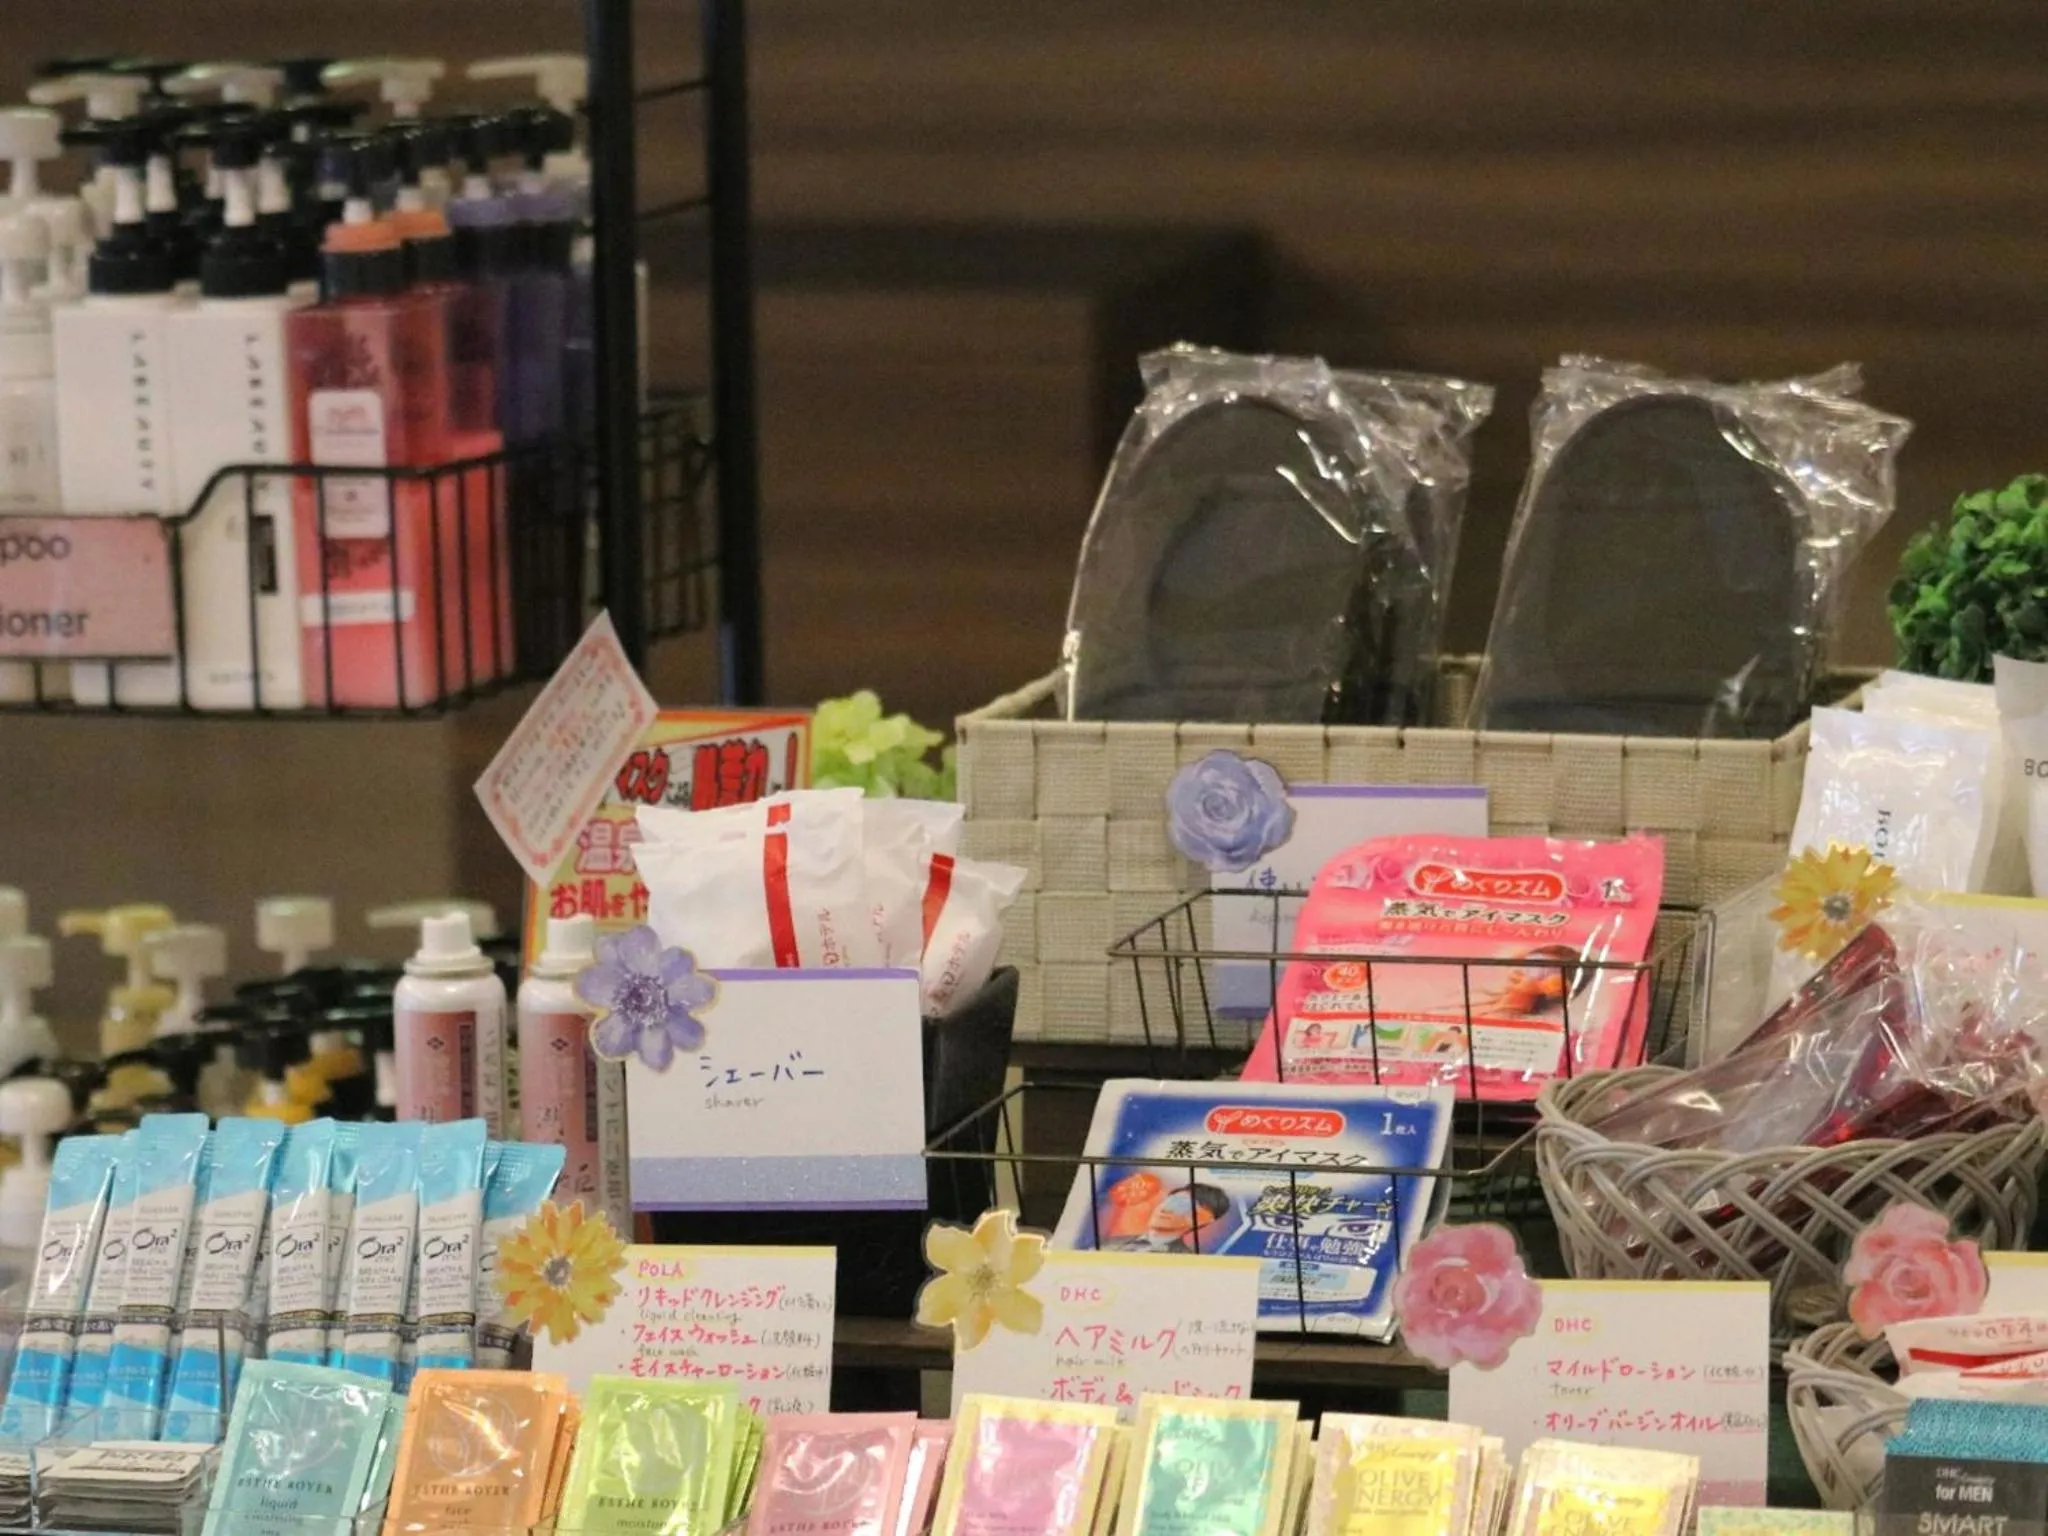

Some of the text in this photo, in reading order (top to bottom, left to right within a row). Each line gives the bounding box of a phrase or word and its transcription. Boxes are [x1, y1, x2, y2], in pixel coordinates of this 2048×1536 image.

[699, 1051, 826, 1088] シェーバー
[704, 1095, 763, 1110] shaver
[1165, 1139, 1370, 1167] 蒸気でアイマスク
[638, 1259, 686, 1278] POLA
[1059, 1285, 1103, 1303] DHC
[1553, 1317, 1594, 1335] DHC
[1053, 1324, 1177, 1360] ヘアミルク
[1546, 1355, 1697, 1384] マイルドローション
[1935, 1484, 1994, 1503] for MEN
[1917, 1511, 2009, 1536] SMART
